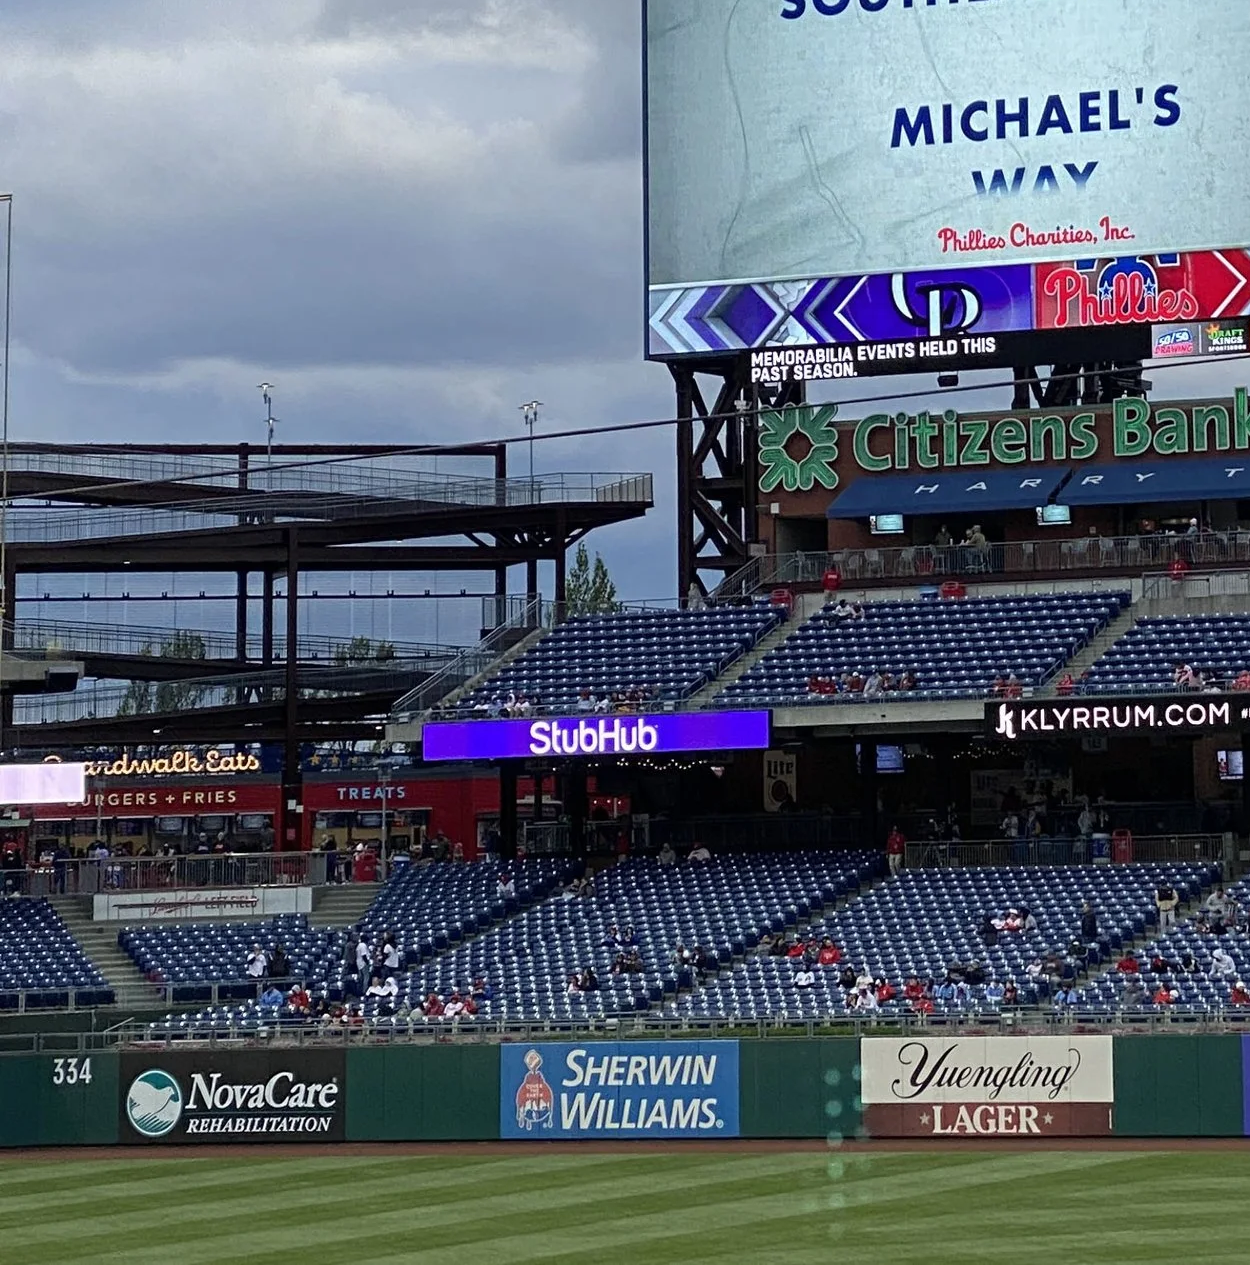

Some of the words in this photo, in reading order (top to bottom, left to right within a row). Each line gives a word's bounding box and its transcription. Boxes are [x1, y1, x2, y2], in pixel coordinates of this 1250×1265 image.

[890, 84, 1181, 148] MICHAEL'S
[971, 161, 1099, 196] WAY
[937, 227, 1005, 253] Phillies
[1010, 222, 1098, 248] Charities,
[1099, 216, 1135, 241] Inc.
[1044, 267, 1199, 327] Phillies
[751, 346, 853, 367] MEMORABILIA
[857, 343, 915, 361] EVENTS
[919, 339, 958, 357] HELD
[962, 336, 996, 354] THIS
[751, 366, 789, 383] PAST
[794, 362, 857, 381] SEASON.
[853, 408, 1099, 473] Citizens
[914, 472, 1155, 495] HARRY
[1021, 702, 1230, 731] KLYRRUM.COM
[529, 718, 657, 754] StubHub
[206, 750, 260, 773] Eats
[183, 791, 237, 804] FRIES
[337, 787, 406, 800] TREATS
[53, 1058, 92, 1085] 334
[562, 1049, 717, 1087] SHERWIN
[891, 1041, 1081, 1100] Yuengling
[186, 1071, 338, 1110] NovaCare
[186, 1114, 331, 1134] REHABILITATION
[560, 1092, 718, 1130] WILLIAMS
[932, 1104, 1041, 1134] LAGER
